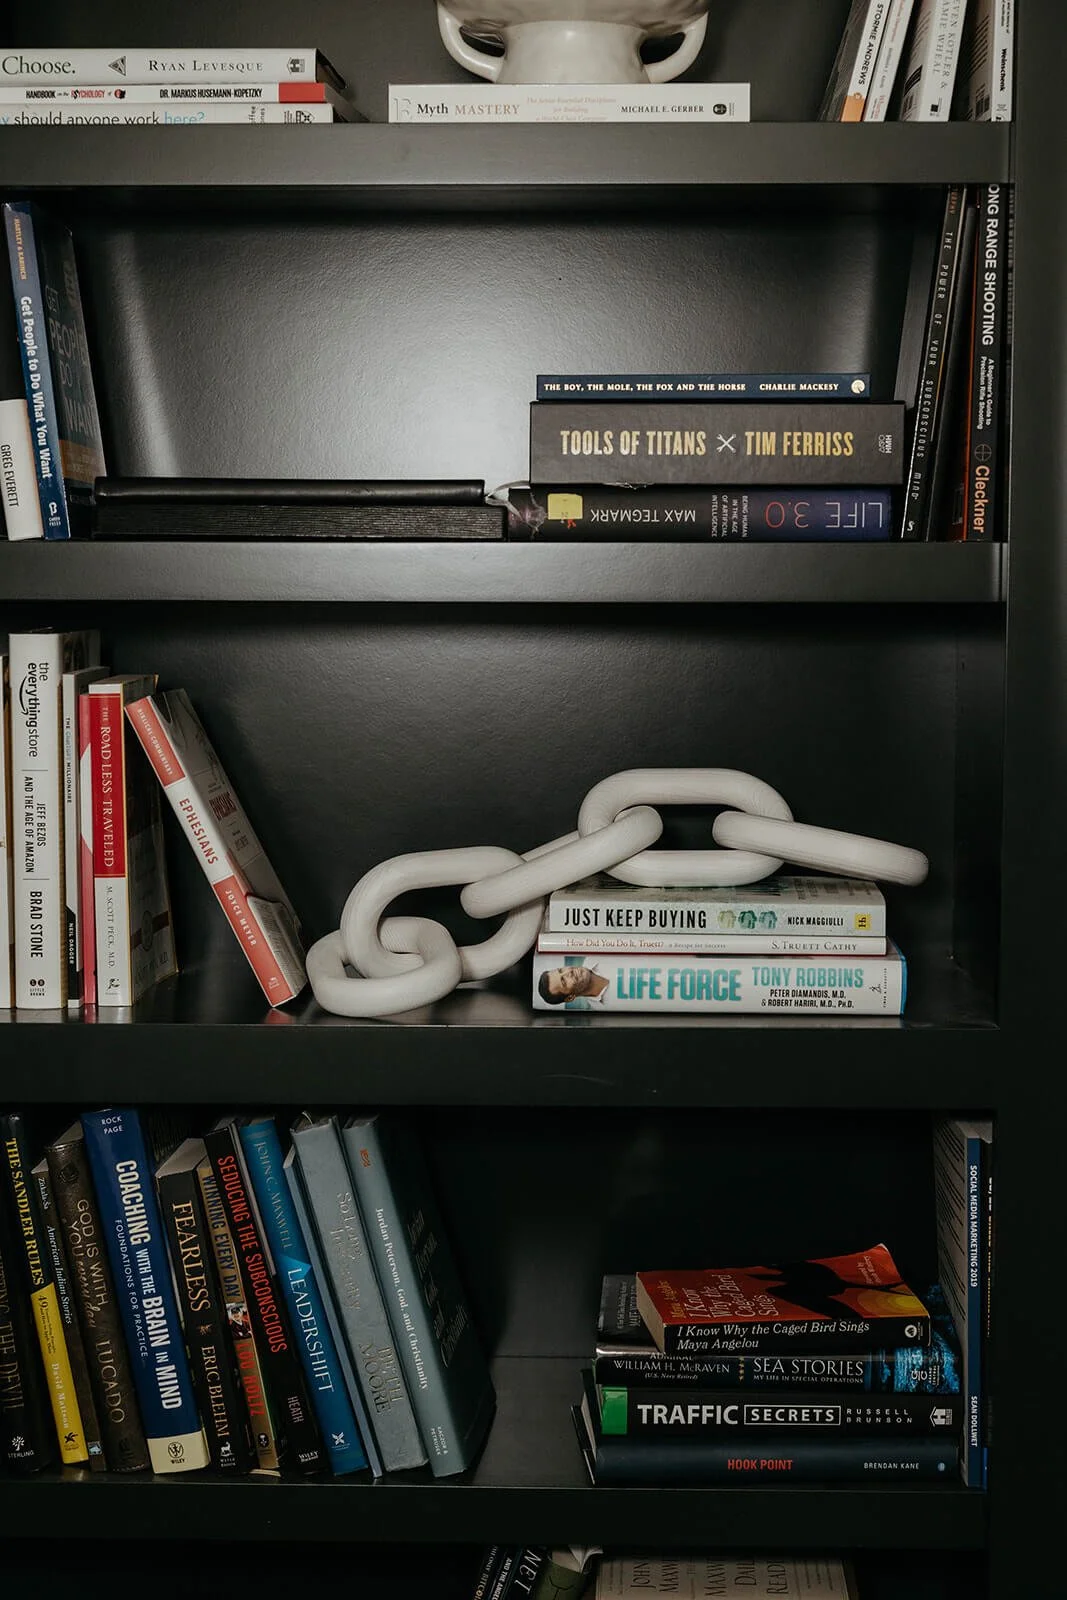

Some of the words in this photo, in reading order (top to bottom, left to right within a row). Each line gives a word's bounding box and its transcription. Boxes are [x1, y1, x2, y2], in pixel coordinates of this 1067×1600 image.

[869, 3, 884, 41] STORMIE
[2, 56, 76, 75] Choose.
[149, 60, 186, 71] RYAN
[193, 60, 264, 73] LEVESQUE
[859, 43, 874, 85] ANDREWS
[933, 33, 945, 74] WHEAL
[14, 112, 62, 125] should
[124, 112, 160, 125] work
[164, 112, 206, 124] here?
[417, 103, 449, 118] Myth
[455, 104, 520, 116] MASTERY
[621, 105, 660, 113] MICHAEL
[662, 105, 669, 113] E.
[671, 105, 704, 113] GERBER
[988, 183, 1000, 215] ONG
[985, 218, 999, 268] RANGE
[21, 296, 34, 316] Get
[982, 271, 997, 346] SHOOTING
[23, 318, 39, 356] People
[28, 357, 39, 371] to
[30, 374, 41, 389] Do
[544, 383, 560, 391] THE
[564, 383, 584, 392] BOY,
[587, 383, 604, 391] THE
[607, 383, 634, 392] MOLE,
[636, 383, 653, 391] THE
[656, 383, 673, 391] FOX
[676, 383, 695, 391] AND
[698, 383, 715, 391] THE
[718, 383, 746, 391] HORSE
[759, 383, 796, 391] CHARLIE
[799, 383, 839, 391] MACKESY
[32, 392, 46, 423] What
[36, 425, 48, 446] You
[560, 430, 614, 456] TOOLS
[619, 430, 640, 456] OF
[646, 430, 706, 456] TITANS
[744, 431, 777, 456] TIM
[783, 431, 854, 456] FERRISS
[1, 444, 10, 469] GREG
[39, 449, 53, 479] Want
[4, 471, 19, 507] EVERETT
[721, 495, 728, 504] OF
[973, 465, 990, 533] Cleckner
[590, 509, 660, 522] TEGMARK
[665, 509, 696, 522] MAX
[765, 501, 810, 528] 3.0
[825, 501, 883, 528] LIFE
[38, 662, 49, 681] the
[100, 726, 112, 760] ROAD
[24, 776, 34, 792] AND
[101, 764, 113, 794] LESS
[25, 793, 34, 809] THE
[36, 803, 46, 819] JEFF
[25, 811, 34, 826] AGE
[179, 798, 219, 865] EPHESIANS
[25, 828, 34, 837] OF
[37, 821, 46, 847] BEZOS
[102, 799, 114, 867] TRAVELED
[25, 839, 35, 873] AMAZON
[30, 891, 43, 920] BRAD
[225, 890, 242, 916] JOYCE
[239, 917, 257, 946] MEYER
[565, 908, 600, 927] JUST
[606, 908, 643, 928] KEEP
[649, 910, 707, 929] BUYING
[788, 917, 804, 926] NICK
[806, 917, 844, 926] MAGGIULLI
[31, 923, 43, 958] STONE
[771, 941, 780, 949] S.
[783, 941, 820, 950] TRUETT
[824, 941, 858, 951] CATHY
[617, 968, 661, 1000] LIFE
[668, 968, 741, 1001] FORCE
[752, 966, 791, 987] TONY
[796, 967, 864, 988] ROBBINS
[770, 989, 790, 997] PETER
[791, 989, 831, 999] DIAMANDIS,
[832, 990, 846, 998] M.D.
[101, 1116, 123, 1125] ROCK
[104, 1125, 123, 1135] PAGE
[5, 1137, 21, 1169] THE
[115, 1160, 151, 1245] COACHING
[202, 1175, 225, 1229] WINNING
[217, 1155, 250, 1223] SEDUCING
[12, 1172, 35, 1237] SANDLER
[77, 1199, 95, 1237] GOD
[86, 1242, 99, 1258] IS
[236, 1224, 259, 1251] THE
[25, 1239, 44, 1286] RULES
[115, 1219, 135, 1289] FOUNDATIONS
[135, 1248, 152, 1274] WITH
[172, 1200, 211, 1312] FEARLESS
[214, 1234, 237, 1270] EVERY
[90, 1262, 109, 1306] WITH
[141, 1275, 156, 1295] THE
[223, 1275, 241, 1298] DAY
[130, 1291, 139, 1311] FOR
[246, 1253, 288, 1353] SUBCONSCIOUS
[134, 1313, 149, 1357] PRACTICE
[142, 1295, 171, 1348] BRAIN
[287, 1268, 335, 1393] LEADERSHIFT
[677, 1326, 683, 1336] I
[686, 1325, 720, 1336] Know
[723, 1325, 749, 1337] Why
[752, 1325, 769, 1335] the
[772, 1322, 808, 1336] Caged
[811, 1321, 836, 1333] Bird
[839, 1320, 870, 1335] Sings
[155, 1351, 169, 1363] IN
[235, 1342, 254, 1369] LOU
[677, 1340, 708, 1351] Maya
[711, 1339, 759, 1351] Angelou
[201, 1346, 220, 1382] ERIC
[614, 1360, 661, 1371] WILLIAM
[664, 1362, 675, 1371] H.
[679, 1362, 730, 1373] McRAVEN
[753, 1357, 785, 1373] SEA
[791, 1359, 864, 1376] STORIES
[96, 1340, 125, 1423] LUCADO
[155, 1364, 183, 1410] MIND
[820, 1376, 864, 1384] OPERATIONS
[243, 1375, 265, 1417] HOLTZ
[208, 1385, 230, 1437] BLEHM
[637, 1404, 739, 1425] TRAFFIC
[751, 1409, 835, 1422] SECRETS
[727, 1459, 757, 1470] HOOK
[759, 1459, 793, 1470] POINT
